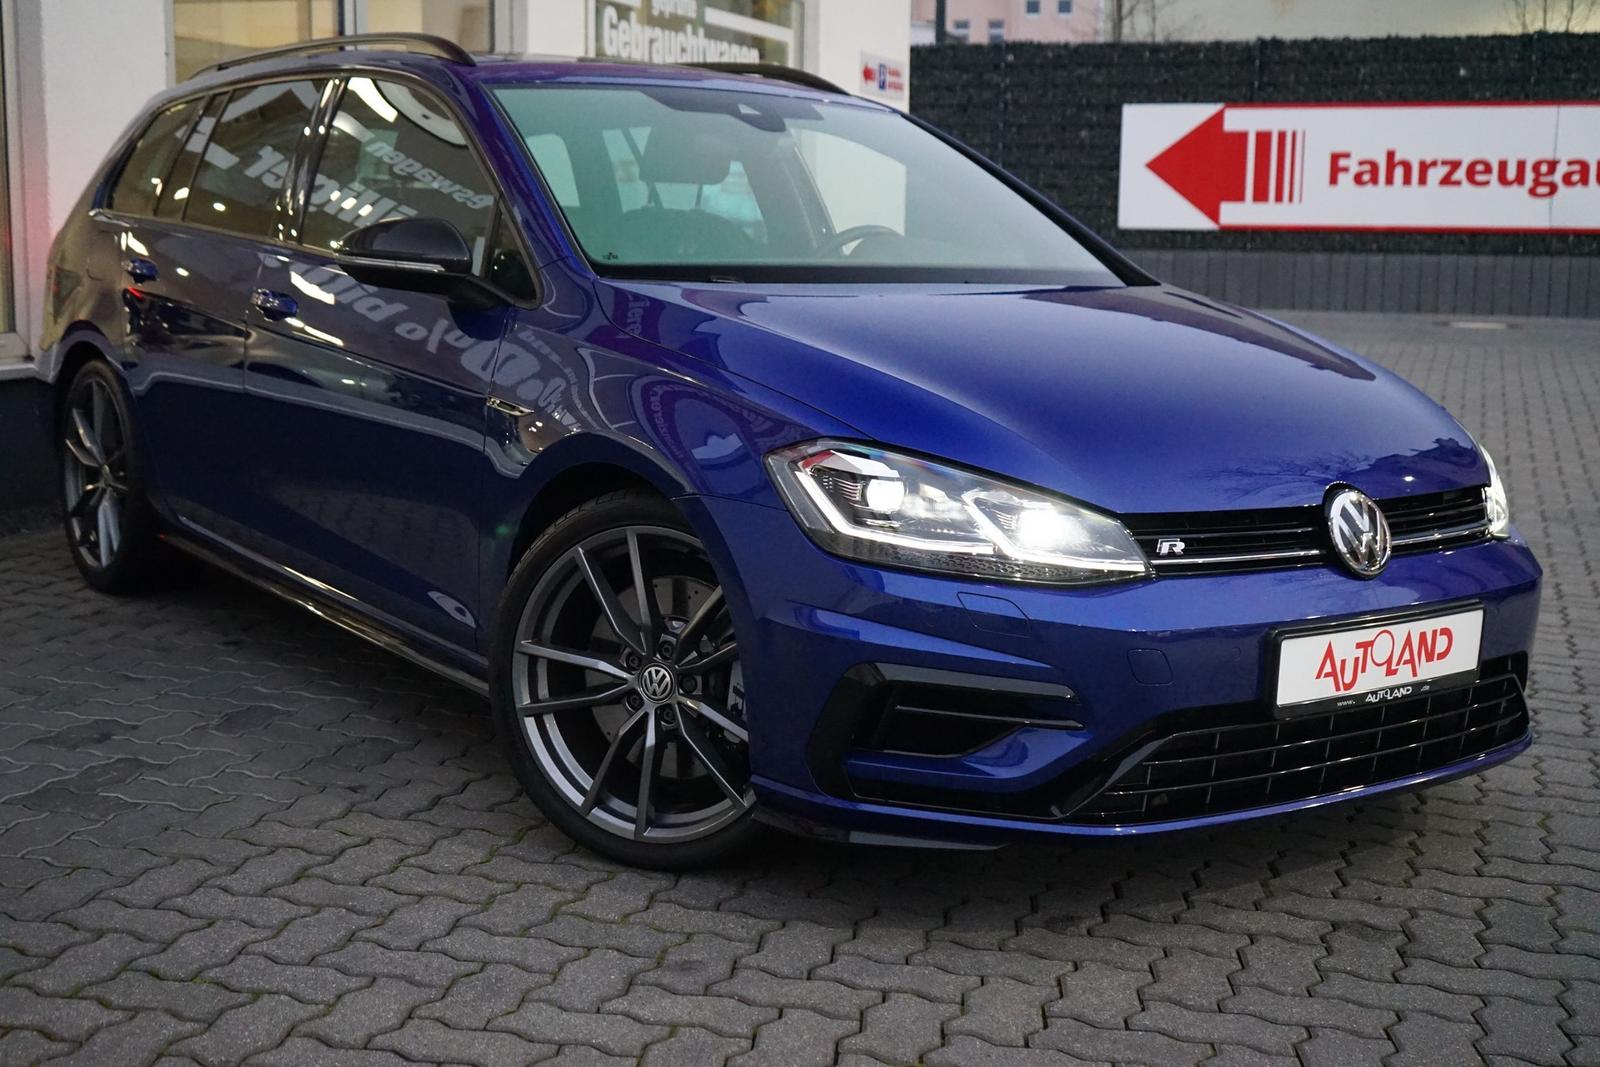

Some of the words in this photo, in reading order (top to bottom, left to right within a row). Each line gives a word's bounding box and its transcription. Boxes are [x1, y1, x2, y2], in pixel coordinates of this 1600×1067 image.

[1328, 148, 1600, 198] Fahrzeuga
[1156, 538, 1186, 556] R
[1315, 627, 1454, 692] AUTOLAND
[1365, 686, 1413, 703] AUTOLAND
